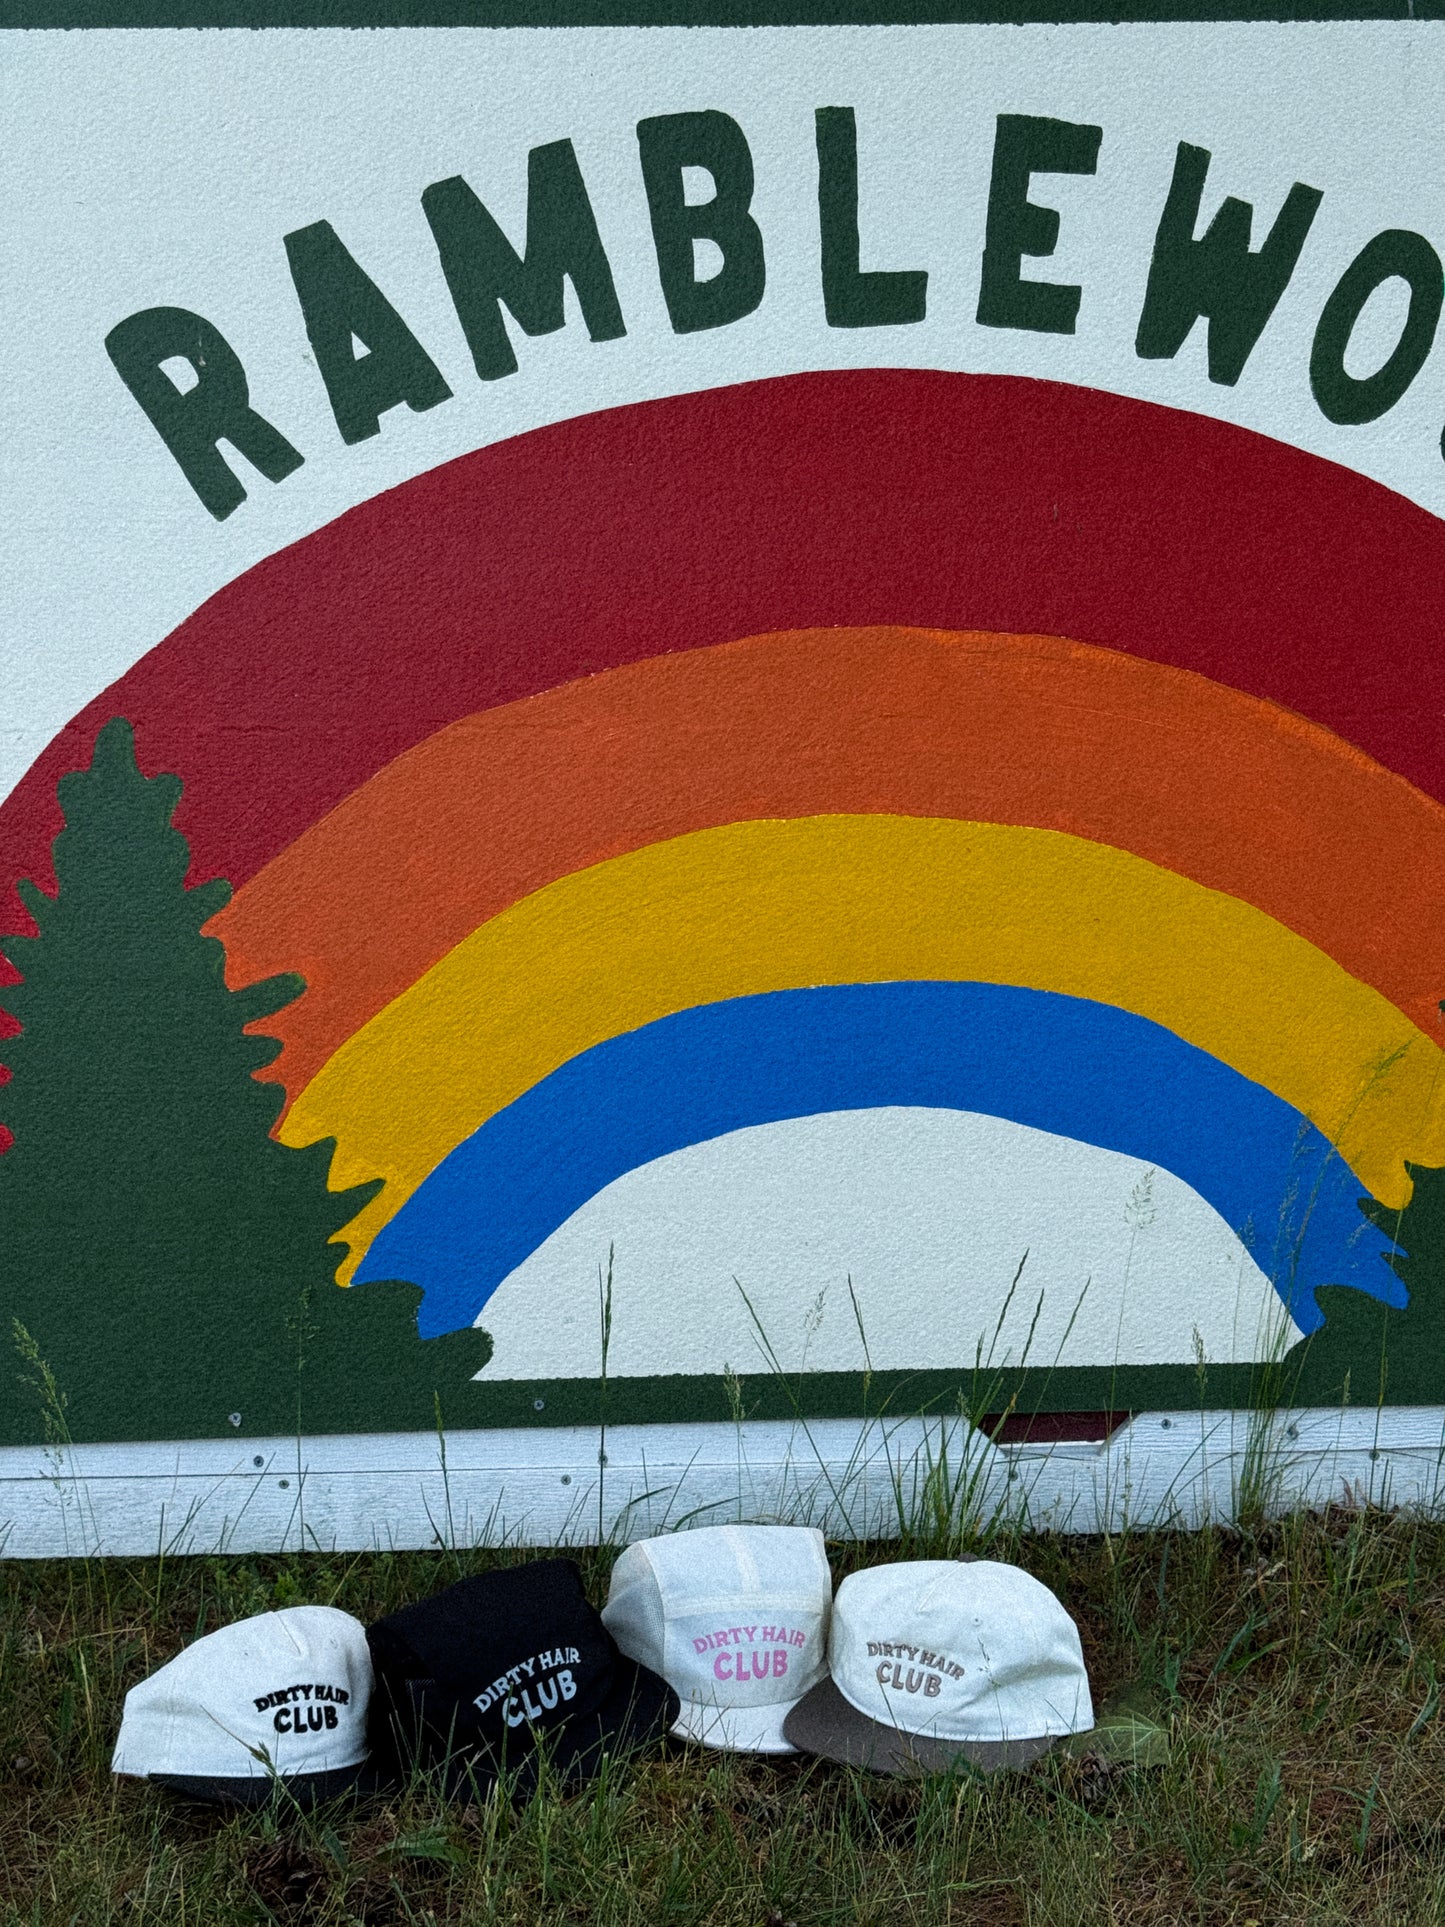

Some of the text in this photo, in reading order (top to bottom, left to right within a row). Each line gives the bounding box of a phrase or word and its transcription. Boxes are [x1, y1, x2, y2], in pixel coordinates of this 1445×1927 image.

[104, 106, 1445, 522] RAMBLEWO
[692, 1626, 806, 1654] DIRTY HAIR
[713, 1649, 788, 1681] CLUB
[866, 1641, 966, 1681] DIRTY HAIR
[876, 1660, 942, 1698] CLUB
[253, 1684, 350, 1713] DIRTY HAIR
[473, 1647, 582, 1714] DIRTY HAIR
[502, 1669, 577, 1728] CLUB
[273, 1705, 339, 1734] CLUB
